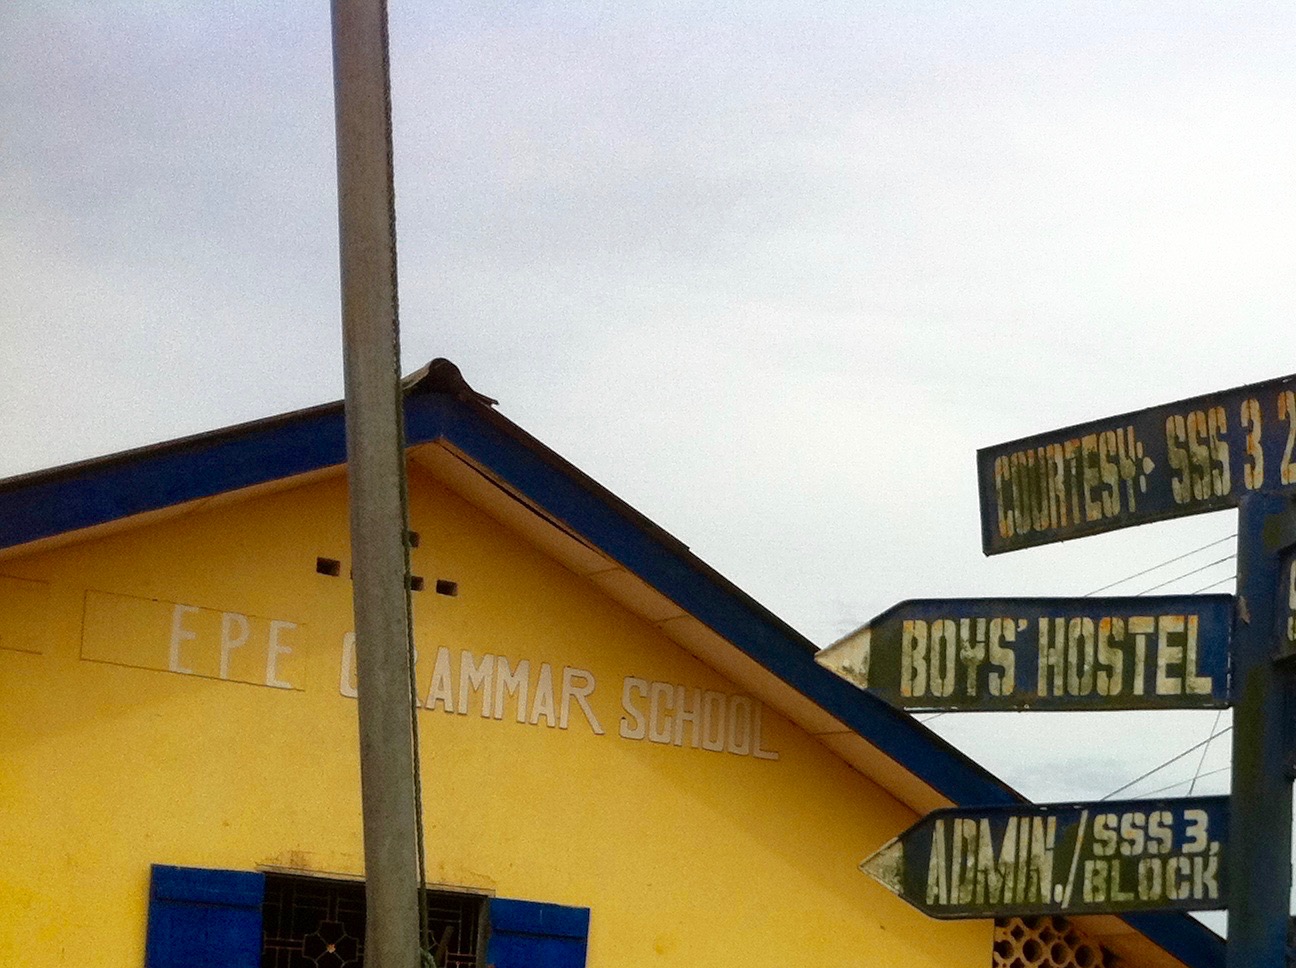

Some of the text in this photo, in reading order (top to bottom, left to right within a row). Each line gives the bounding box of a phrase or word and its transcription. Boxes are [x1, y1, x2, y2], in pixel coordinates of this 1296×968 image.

[1165, 406, 1231, 504] SSS
[1240, 398, 1265, 491] 3
[168, 603, 299, 690] EPE
[619, 675, 780, 760] SCHOOL
[900, 614, 1213, 698] BOYS' HOSTEL
[1092, 811, 1174, 856] SSS
[1083, 855, 1219, 904] BLOCK
